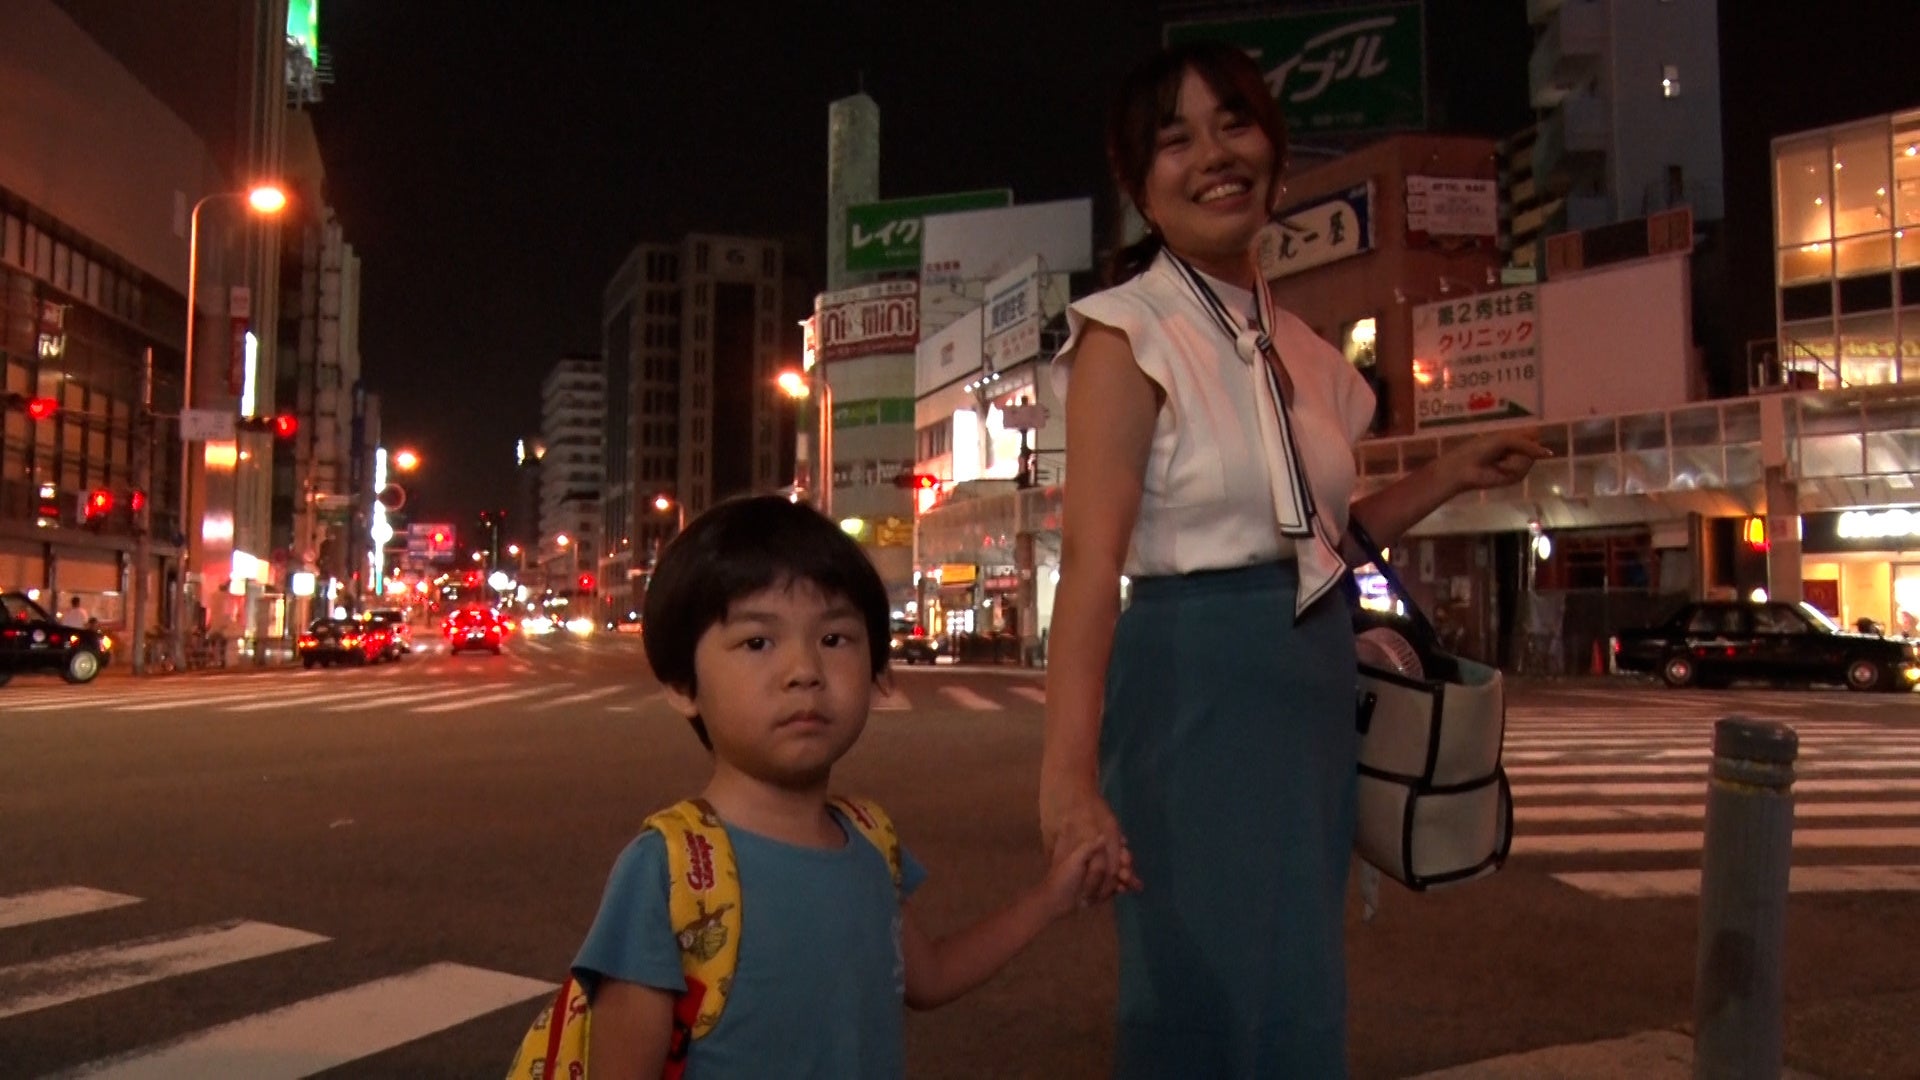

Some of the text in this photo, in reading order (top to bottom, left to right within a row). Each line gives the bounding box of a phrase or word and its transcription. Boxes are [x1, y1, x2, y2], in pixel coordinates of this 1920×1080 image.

[1250, 16, 1397, 102] イブル
[852, 218, 920, 249] レイク
[1439, 321, 1533, 353] クリニック
